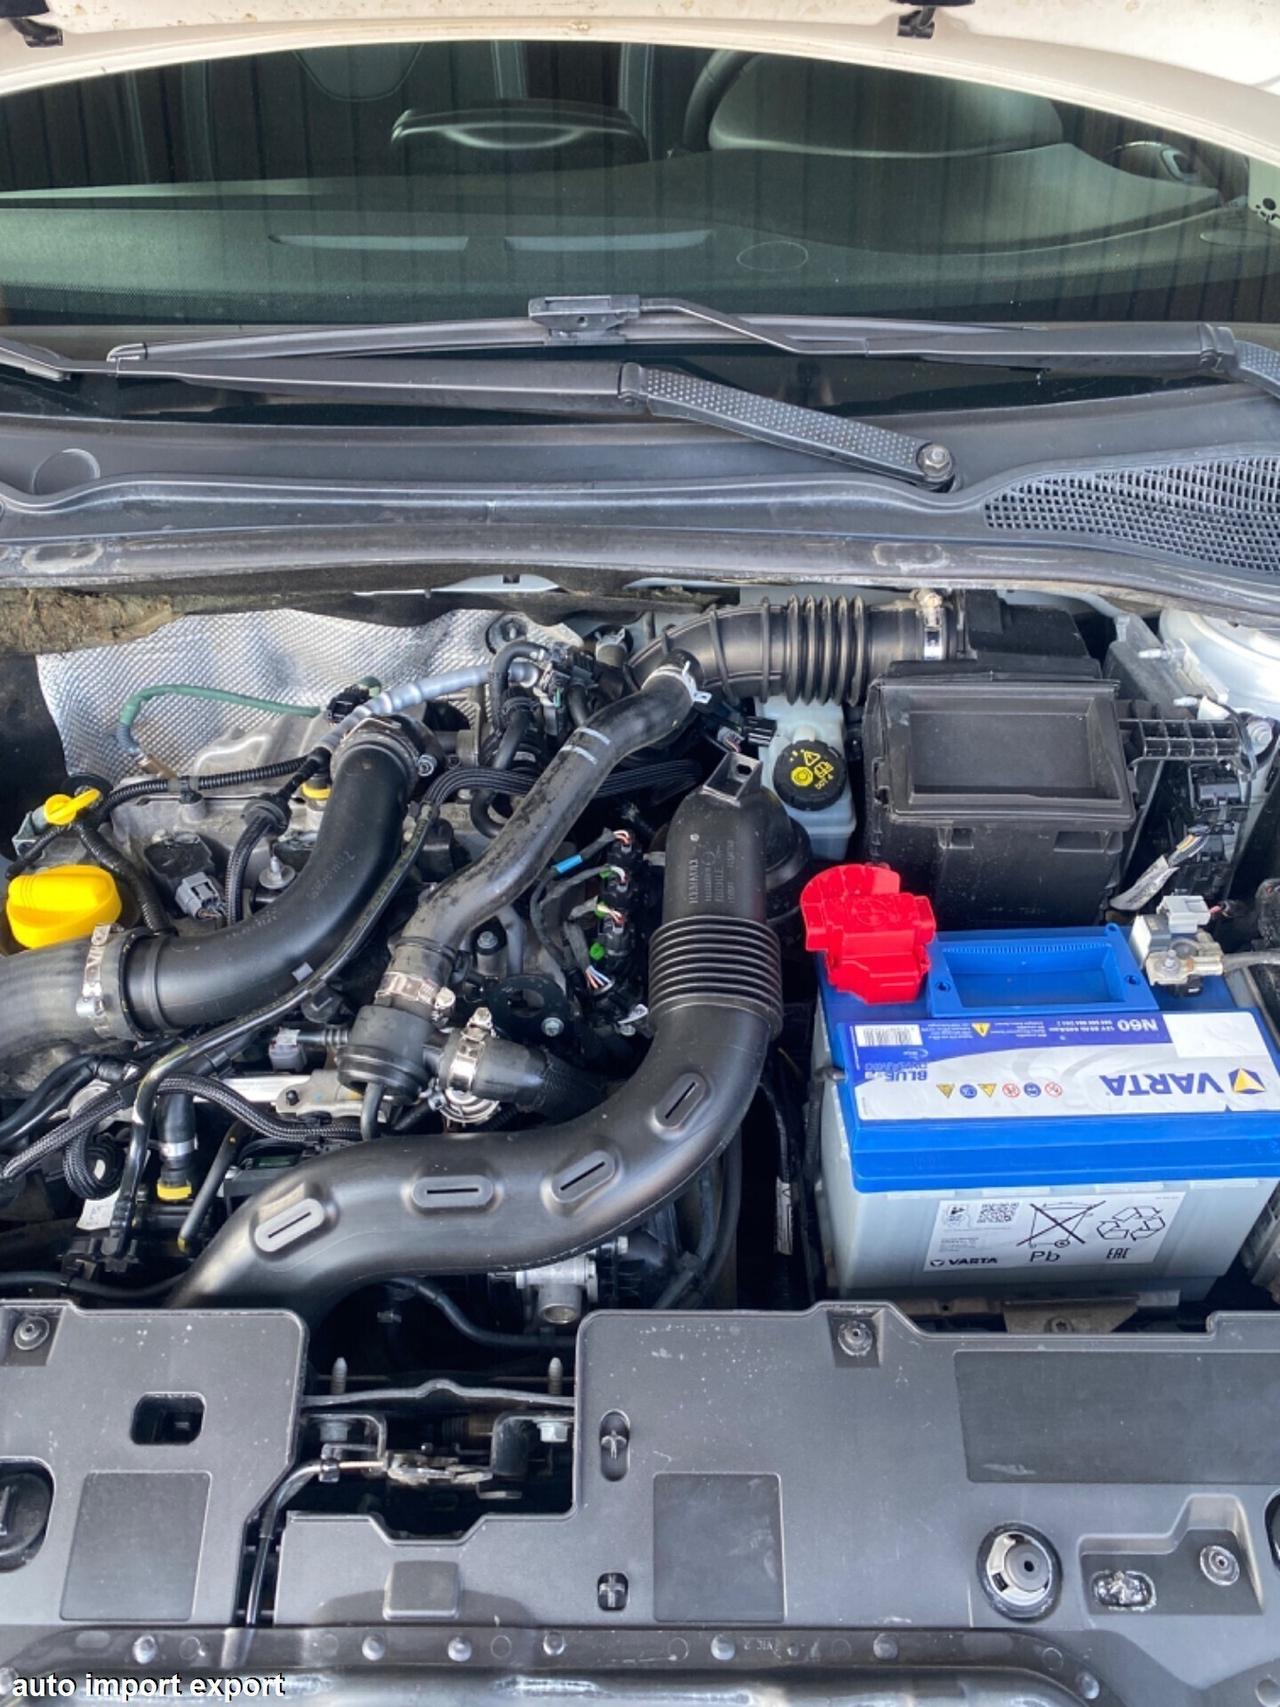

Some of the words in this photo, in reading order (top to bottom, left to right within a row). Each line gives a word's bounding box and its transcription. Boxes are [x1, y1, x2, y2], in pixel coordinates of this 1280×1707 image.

[1117, 1018, 1159, 1032] N60
[886, 1070, 928, 1081] BLUE
[1099, 1072, 1225, 1097] VARTA
[949, 1256, 999, 1266] VARTA
[1029, 1249, 1061, 1264] Pb
